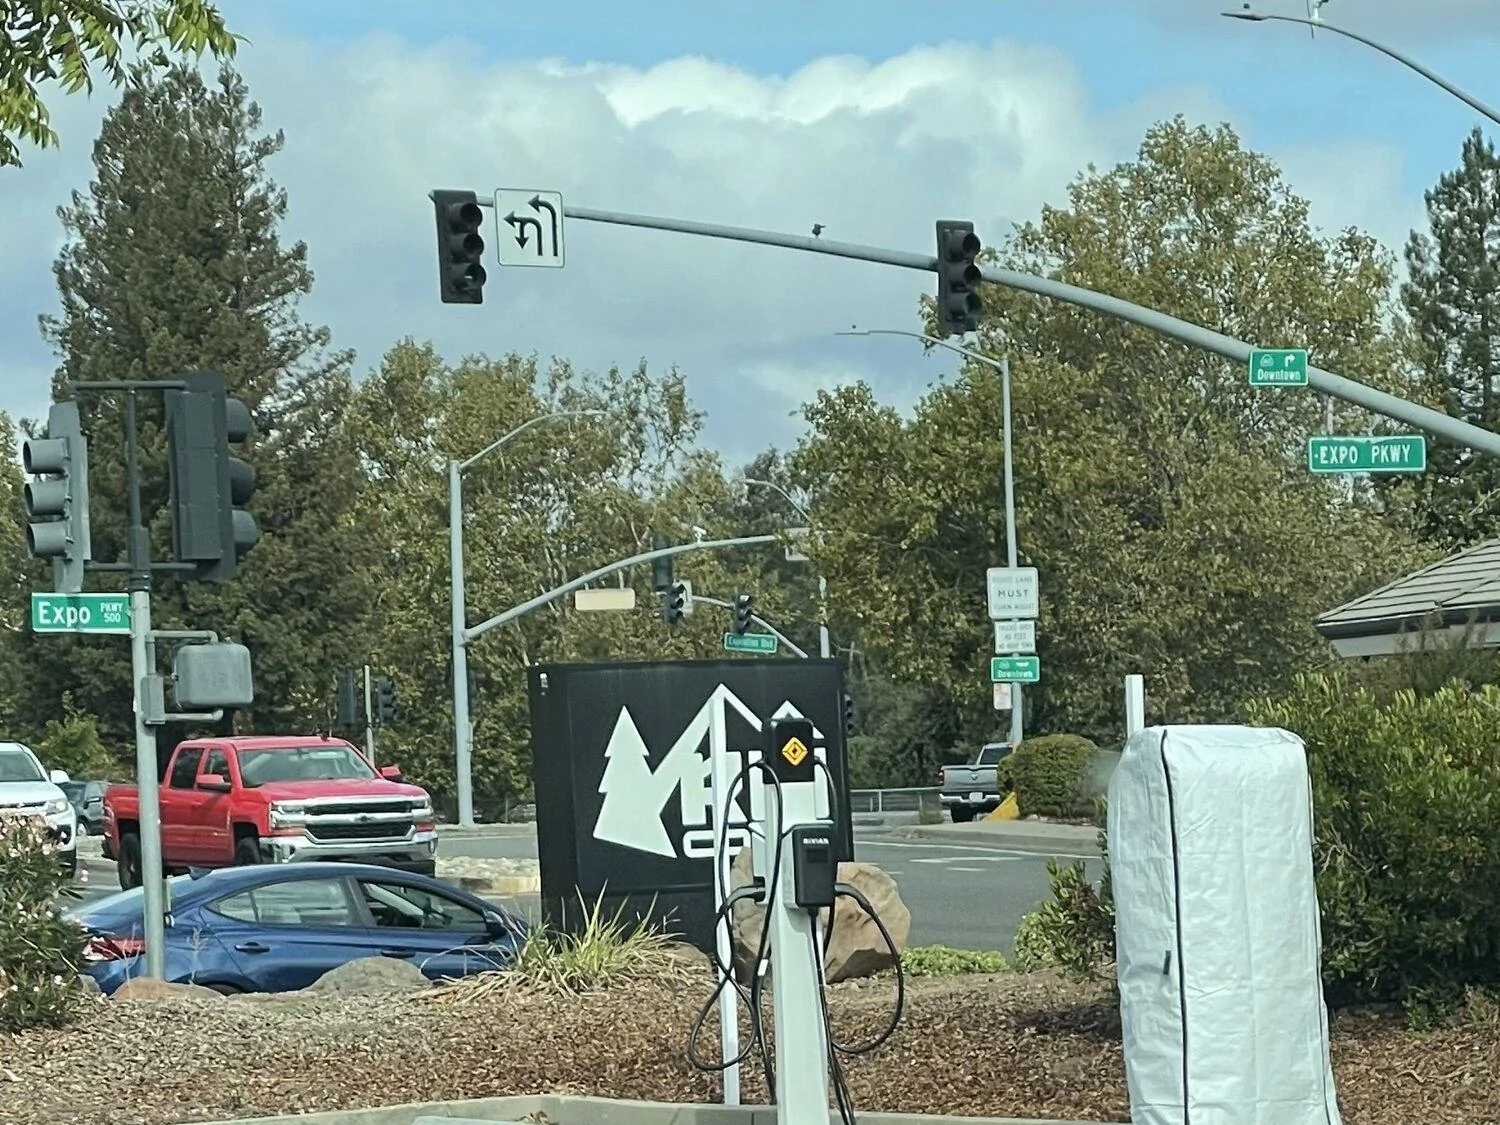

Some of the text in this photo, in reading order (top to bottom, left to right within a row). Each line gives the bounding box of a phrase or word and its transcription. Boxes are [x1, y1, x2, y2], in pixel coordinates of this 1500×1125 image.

[1257, 368, 1301, 381] Downtown
[1319, 444, 1411, 464] EXPO PKWY
[998, 589, 1029, 598] MUST
[100, 602, 123, 612] PKWY
[37, 601, 91, 628] Expo
[103, 612, 121, 623] 500
